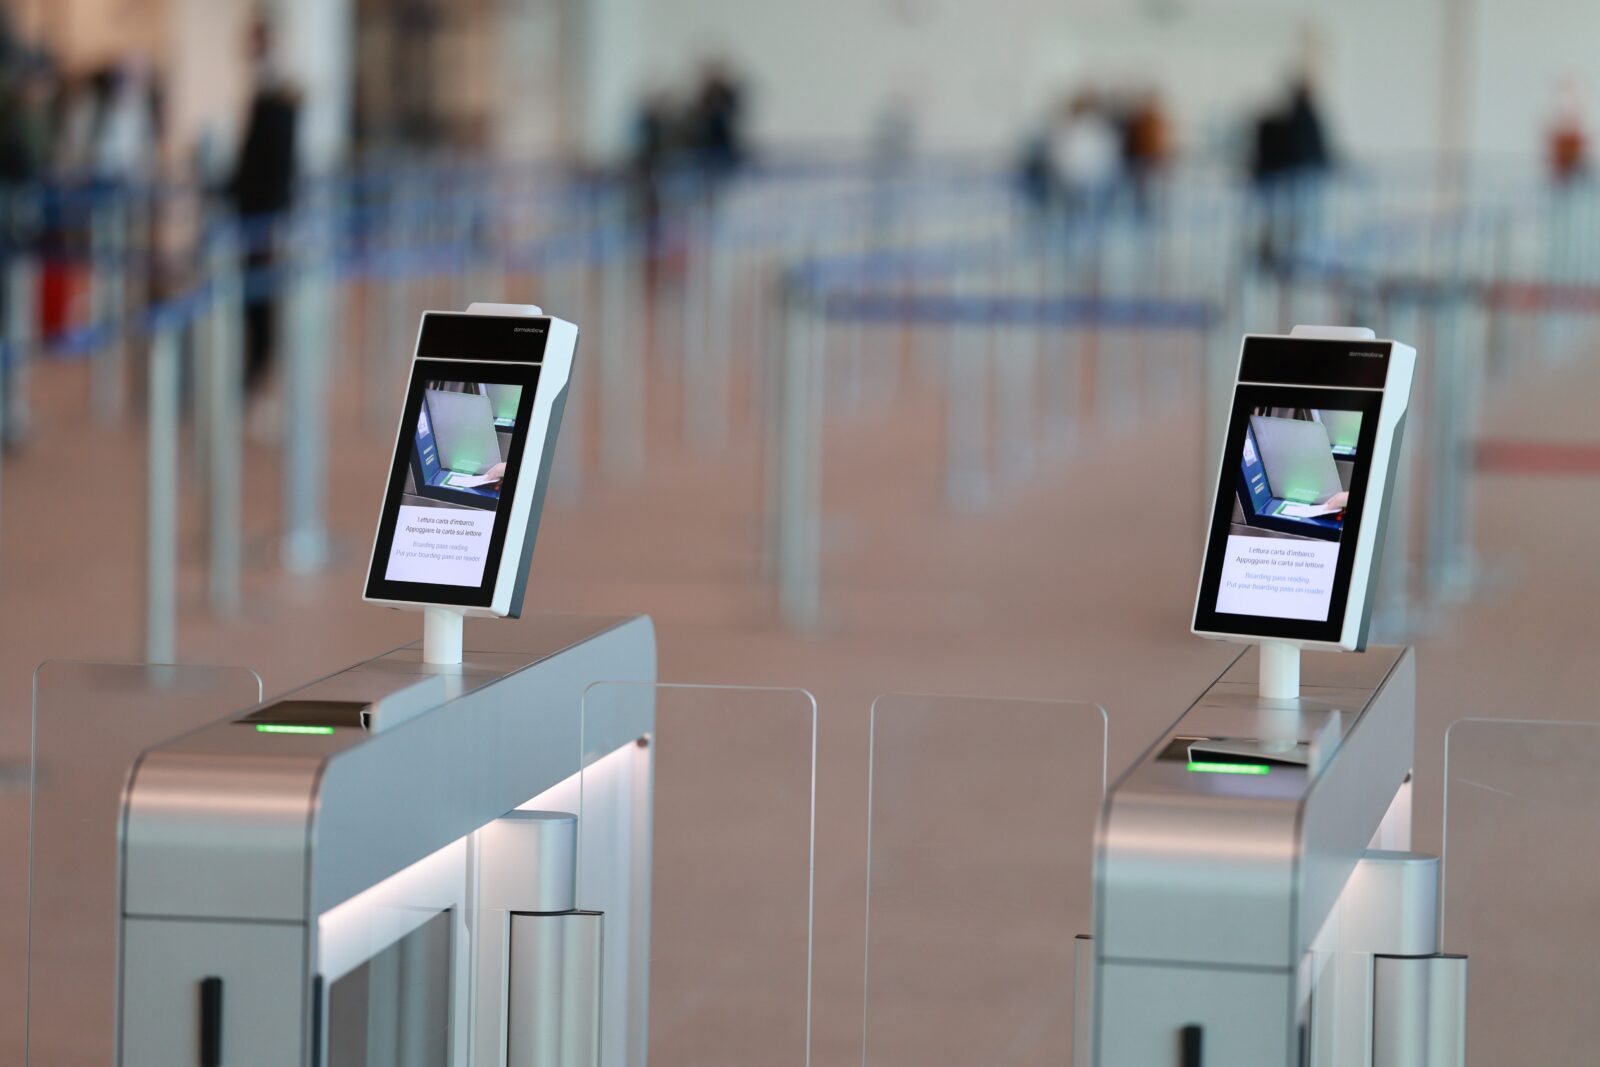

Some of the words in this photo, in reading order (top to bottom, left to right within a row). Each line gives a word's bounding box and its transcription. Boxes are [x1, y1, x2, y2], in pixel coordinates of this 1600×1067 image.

[406, 526, 435, 534] Appoggiare
[1287, 549, 1315, 558] d'imbarco
[1236, 556, 1269, 565] Appoggiare
